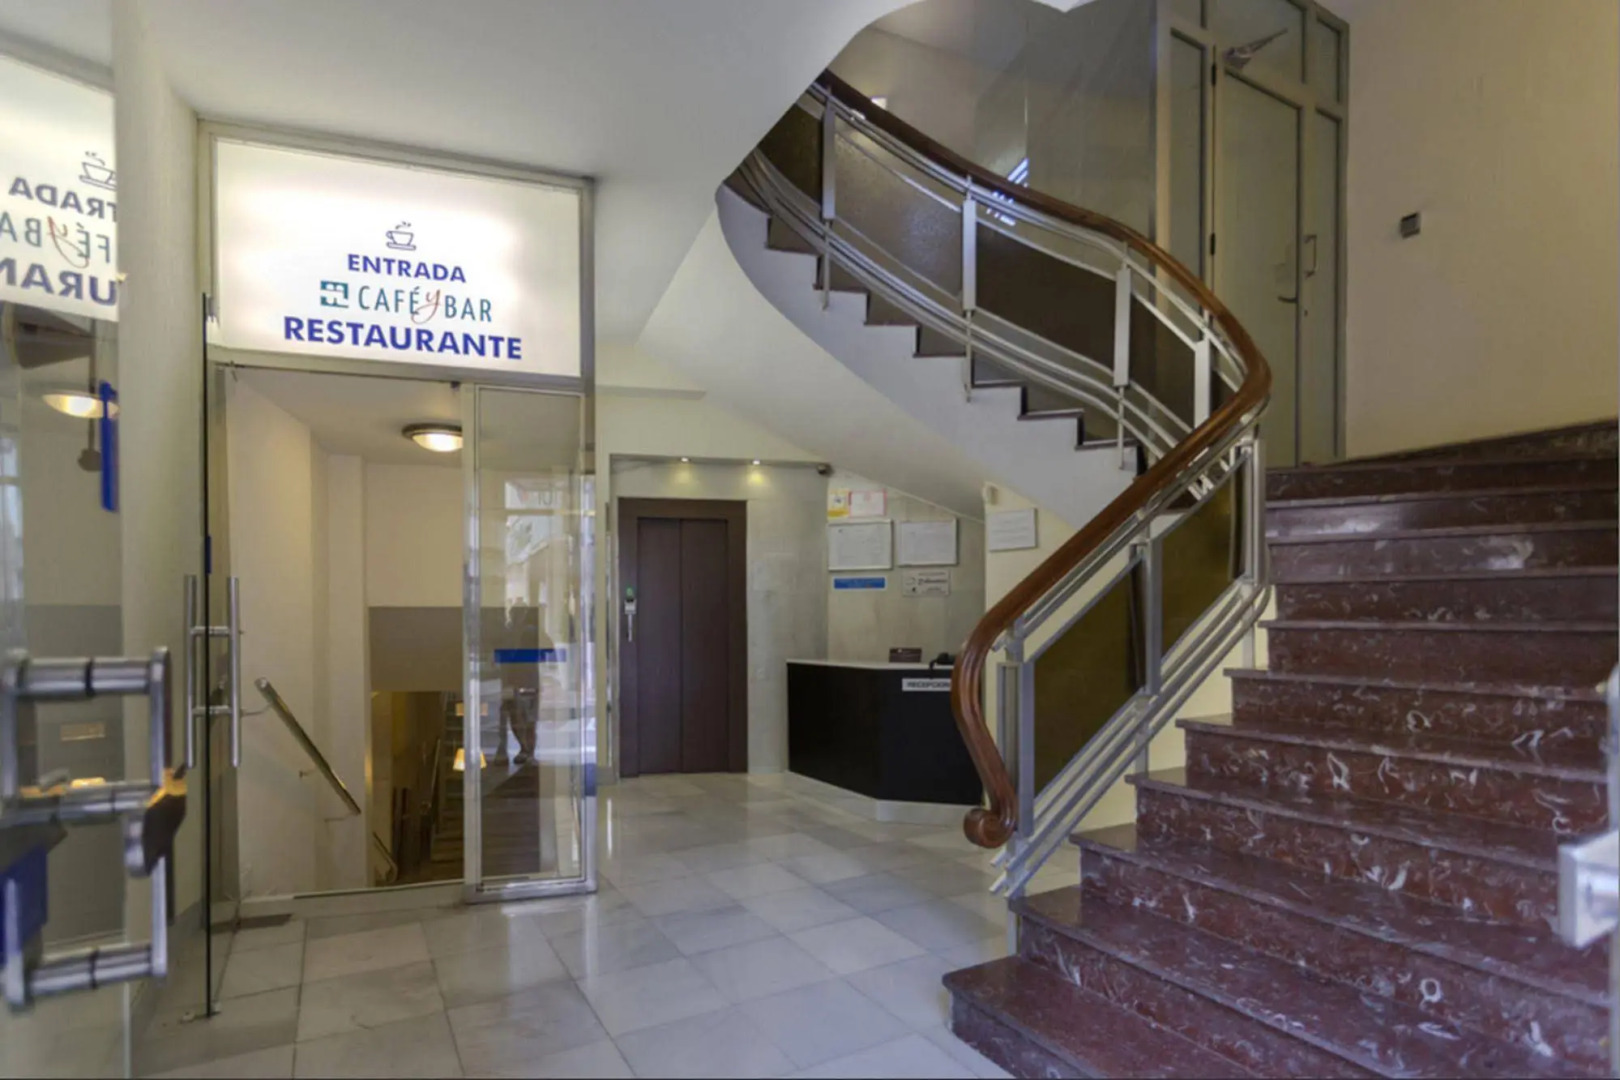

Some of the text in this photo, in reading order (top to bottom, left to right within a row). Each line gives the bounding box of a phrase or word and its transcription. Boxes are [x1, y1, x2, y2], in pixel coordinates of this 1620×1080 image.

[347, 253, 466, 283] ENTRADA
[444, 295, 492, 322] BAR
[284, 316, 522, 359] RESTAURANTE
